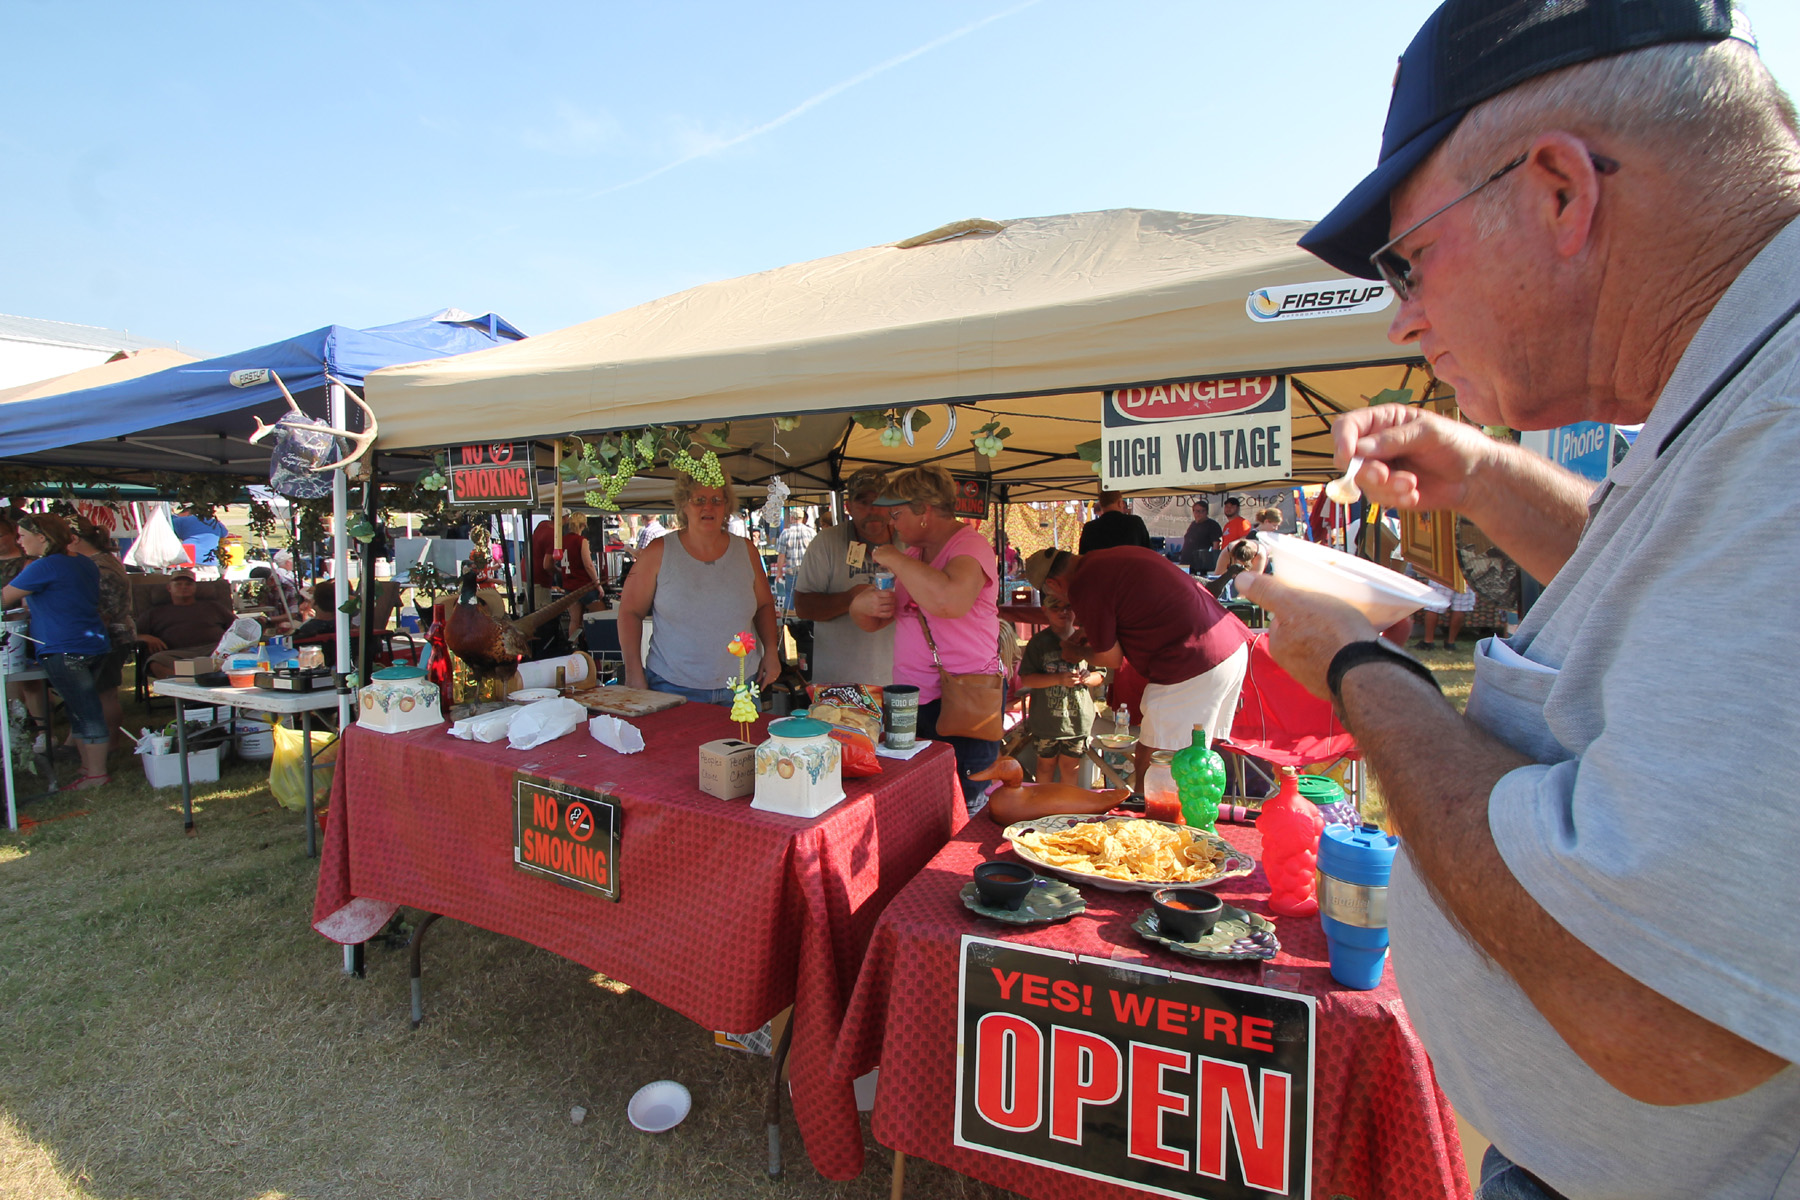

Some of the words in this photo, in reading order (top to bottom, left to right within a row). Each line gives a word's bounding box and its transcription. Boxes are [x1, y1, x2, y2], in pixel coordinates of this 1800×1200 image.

[1281, 286, 1385, 309] FIRST-UP
[1126, 376, 1263, 408] DANGER
[461, 444, 483, 465] NO
[1108, 436, 1162, 478] HIGH
[1175, 425, 1282, 473] VOLTAGE
[1561, 424, 1605, 464] Phone
[454, 467, 528, 498] SMOKING
[954, 497, 984, 513] OKING
[561, 549, 571, 575] 4
[533, 793, 558, 831] NO
[523, 828, 607, 885] SMOKING
[990, 966, 1094, 1016] YES!
[1108, 989, 1275, 1053] WE'RE
[974, 1011, 1293, 1196] OPEN
